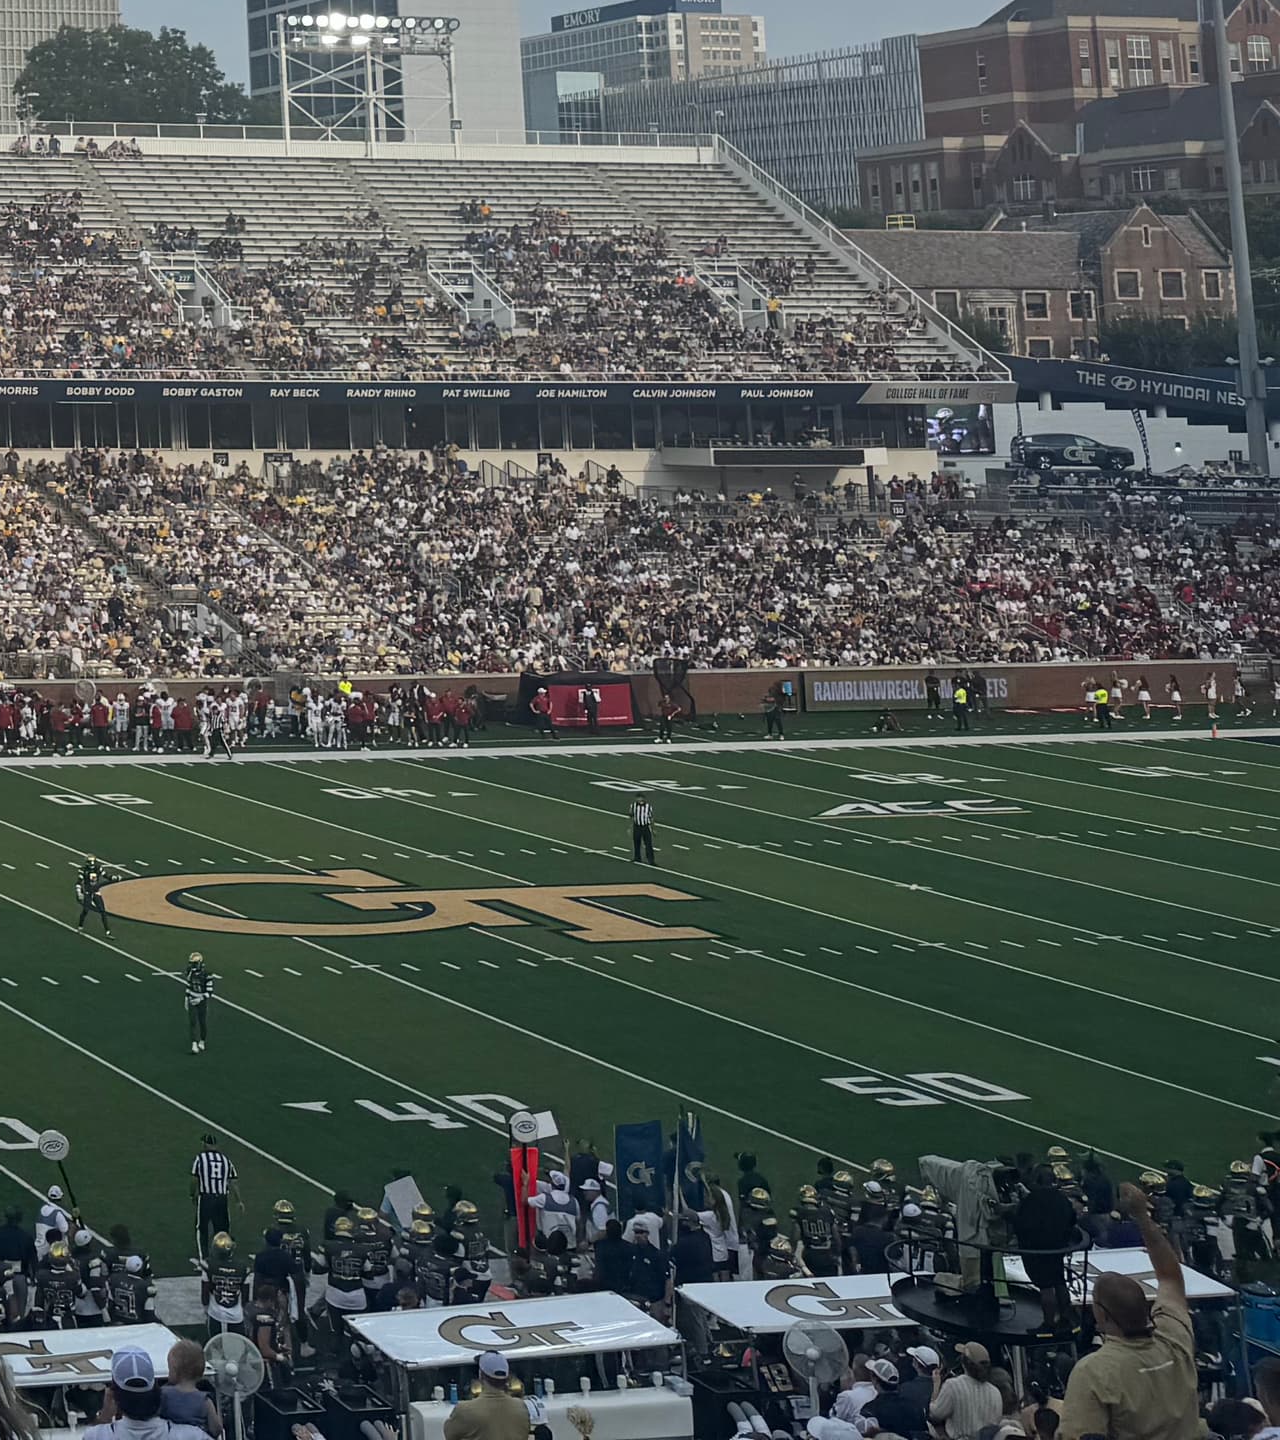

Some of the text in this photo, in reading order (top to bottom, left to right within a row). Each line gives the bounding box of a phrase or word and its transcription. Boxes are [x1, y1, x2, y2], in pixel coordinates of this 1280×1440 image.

[563, 8, 601, 28] EMORY
[66, 387, 135, 396] BOBBY DODD
[162, 387, 243, 397] BOBBY GASTON
[270, 388, 320, 397] RAY BECK
[346, 388, 416, 397] RANDY RHINO
[442, 389, 510, 398] PAT SWILLING
[536, 389, 608, 398] JOE HAMILTON
[633, 389, 716, 398] CALVIN JOHNSON
[740, 389, 814, 398] PAUL JOHNSON
[886, 388, 969, 400] COLLEGE HALL OF FAME
[1076, 370, 1247, 406] THE HYUNDAI NES
[1064, 446, 1095, 464] GT
[818, 799, 1023, 816] ACC
[96, 867, 724, 944] GT
[820, 1072, 1032, 1106] 50
[210, 1161, 222, 1179] H
[626, 1161, 655, 1187] GT
[765, 1282, 907, 1322] GT
[438, 1312, 584, 1351] GT
